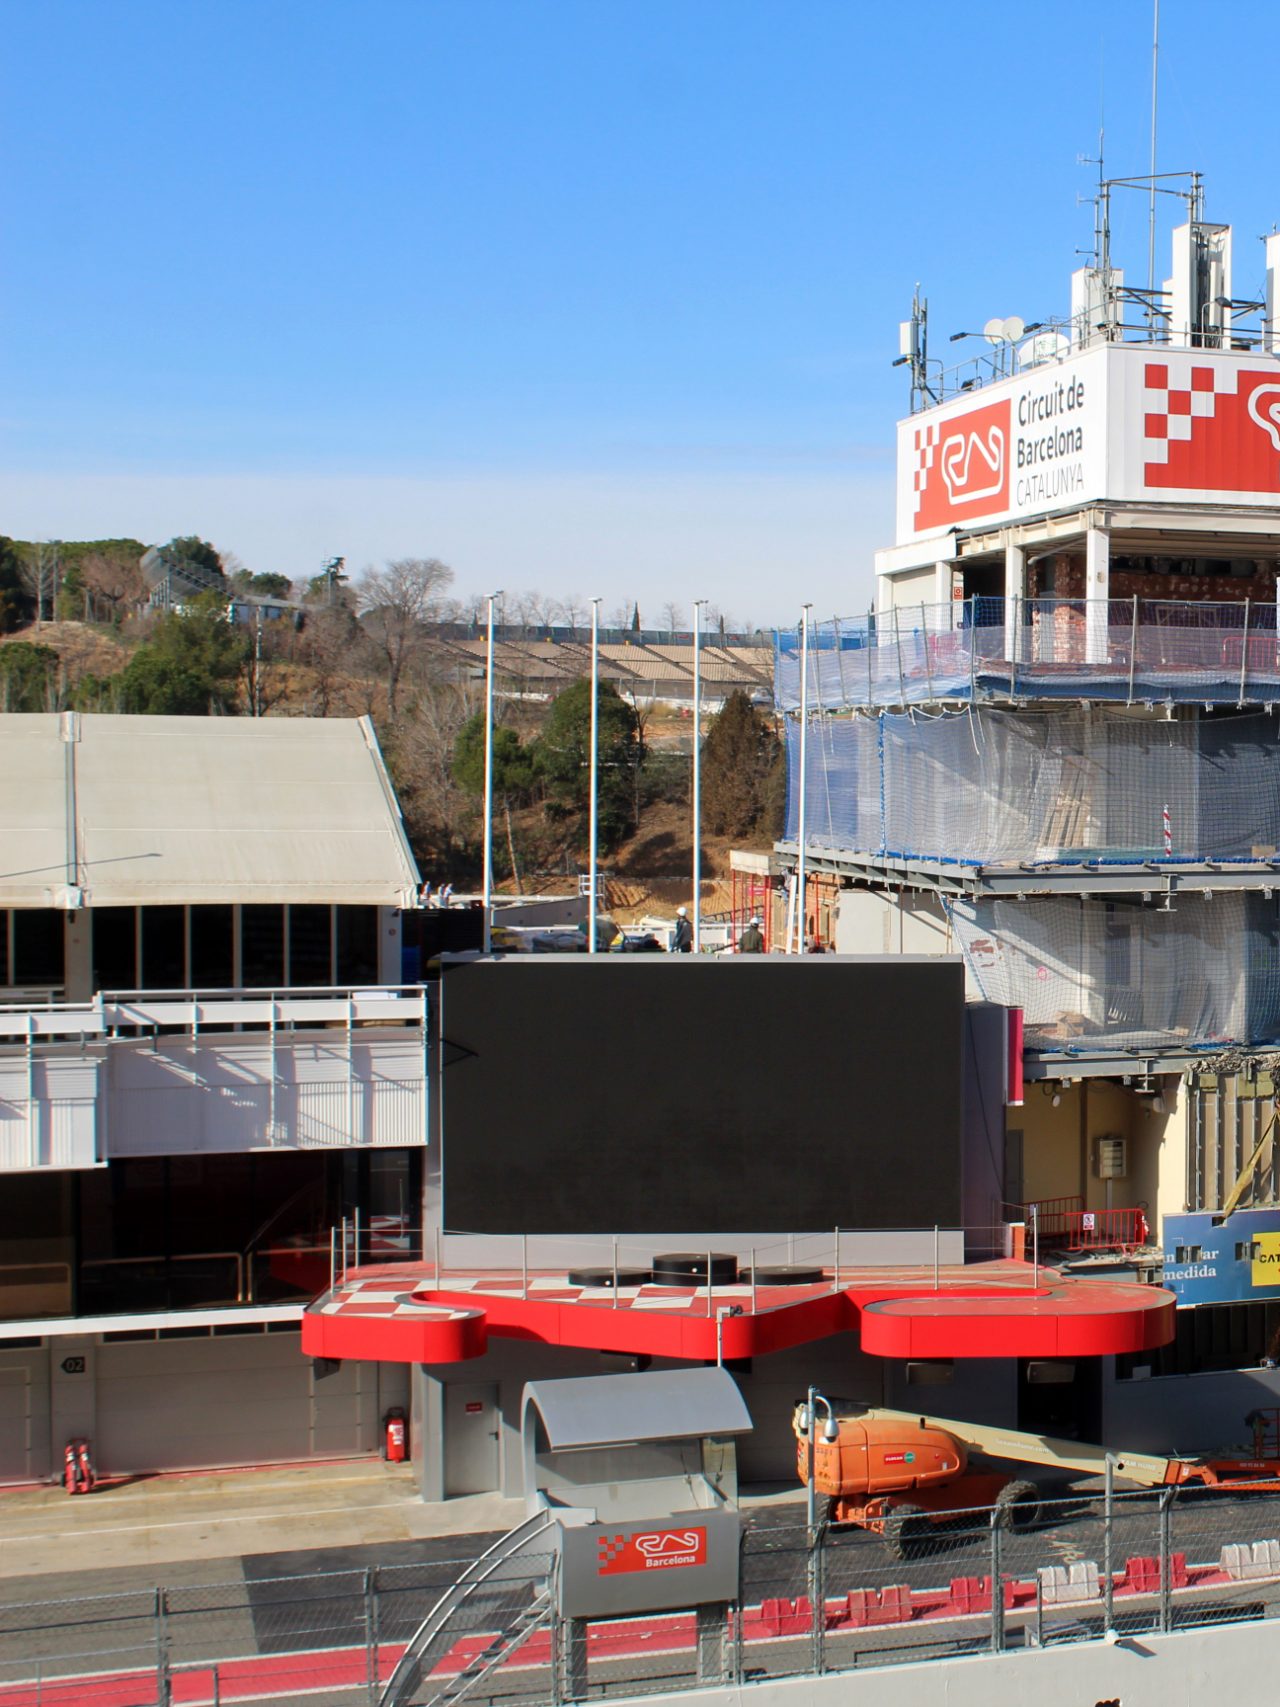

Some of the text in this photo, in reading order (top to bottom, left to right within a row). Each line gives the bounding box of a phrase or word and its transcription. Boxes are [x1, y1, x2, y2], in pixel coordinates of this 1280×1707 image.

[1018, 374, 1084, 427] Circuit de
[1017, 425, 1083, 469] Barcelona
[1016, 463, 1084, 507] CATALUNYA
[1163, 1264, 1217, 1281] medida
[66, 1360, 83, 1371] 02
[646, 1555, 695, 1567] Barcelona
